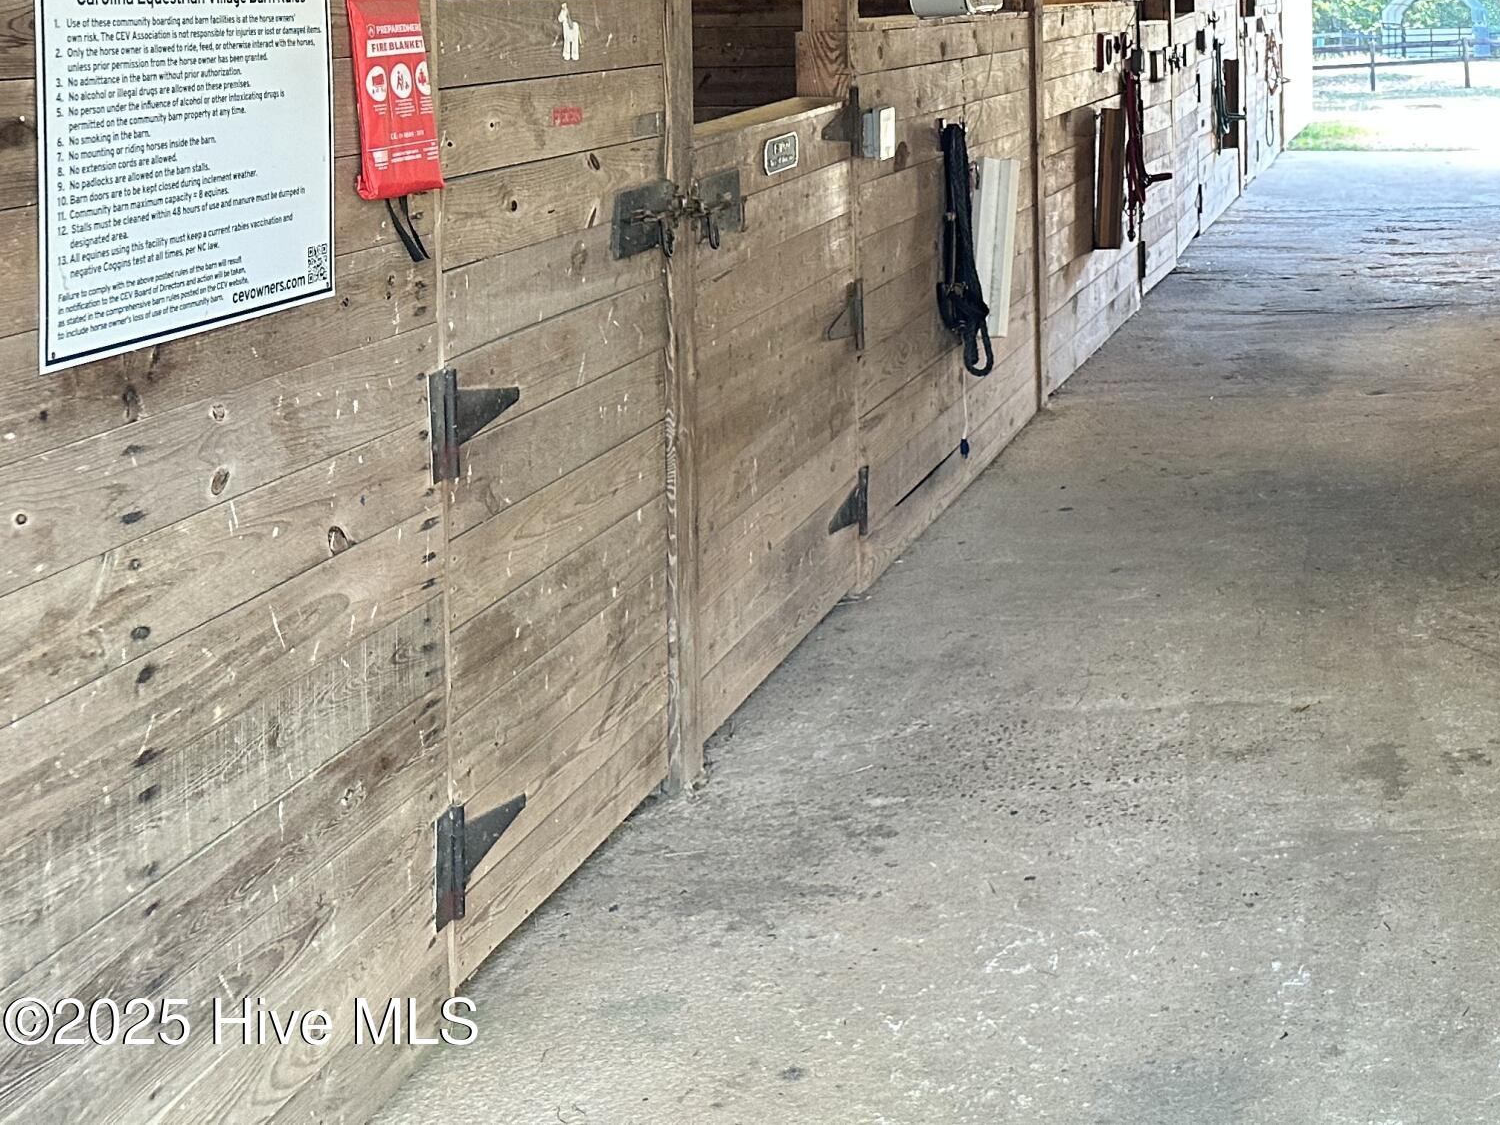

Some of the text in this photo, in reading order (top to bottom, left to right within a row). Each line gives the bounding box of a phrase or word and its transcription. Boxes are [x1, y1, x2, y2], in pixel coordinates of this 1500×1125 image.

[66, 18, 80, 27] Use
[91, 17, 111, 27] these
[112, 17, 150, 28] community
[151, 16, 180, 27] boarding
[182, 15, 193, 24] and
[194, 15, 209, 24] barn
[209, 15, 235, 23] facilities
[248, 14, 258, 22] the
[371, 39, 422, 53] FIRE BLANKET
[67, 61, 91, 72] unless
[92, 61, 109, 72] prior
[111, 59, 149, 71] permission
[150, 57, 166, 67] from
[167, 57, 177, 66] the
[197, 56, 216, 64] owner
[217, 54, 228, 63] has
[229, 53, 243, 62] been
[244, 52, 267, 63] granted.
[80, 74, 120, 86] admittance
[129, 72, 140, 82] the
[142, 71, 157, 81] barn
[159, 70, 183, 80] without
[184, 69, 199, 80] prior
[80, 89, 107, 100] alcohol
[117, 87, 137, 99] illegal
[139, 85, 157, 97] drugs
[159, 86, 170, 94] are
[171, 82, 195, 93] allowed
[205, 80, 222, 90] these
[80, 105, 105, 117] person
[106, 102, 126, 113] under
[128, 101, 139, 111] the
[140, 98, 171, 110] influence
[180, 95, 202, 106] alcohol
[211, 93, 227, 103] other
[263, 89, 279, 100] drugs
[68, 118, 104, 133] permitted
[116, 116, 128, 126] the
[129, 113, 166, 126] community
[168, 111, 182, 121] barn
[183, 108, 210, 121] property
[219, 108, 230, 117] any
[231, 105, 244, 114] time.
[80, 146, 115, 161] mounting
[124, 142, 145, 155] riding
[146, 140, 168, 151] horses
[169, 137, 188, 148] inside
[189, 136, 199, 146] the
[200, 134, 216, 144] barn.
[81, 132, 111, 146] smoking
[120, 130, 132, 140] the
[133, 128, 150, 138] barn.
[81, 161, 116, 174] extension
[118, 157, 137, 169] cords
[138, 157, 149, 166] are
[151, 152, 177, 164] allowed.
[81, 175, 113, 190] padlocks
[115, 175, 126, 184] are
[127, 169, 153, 182] allowed
[164, 166, 175, 176] the
[176, 164, 191, 175] barn
[192, 161, 209, 172] stalls.
[69, 193, 88, 205] Barn
[89, 190, 109, 202] doors
[111, 189, 122, 199] are
[142, 183, 157, 195] kept
[158, 179, 179, 191] closed
[180, 176, 201, 189] during
[201, 172, 231, 184] inclement
[233, 168, 256, 180] weather.
[69, 204, 111, 221] Community
[112, 201, 129, 212] barn
[164, 191, 192, 205] capacity
[204, 186, 229, 199] equines.
[70, 264, 101, 280] negative
[132, 255, 146, 266] test
[155, 250, 163, 261] all
[164, 247, 183, 260] times,
[185, 246, 195, 256] per
[207, 239, 218, 250] law.
[232, 275, 305, 303] cevowners.com
